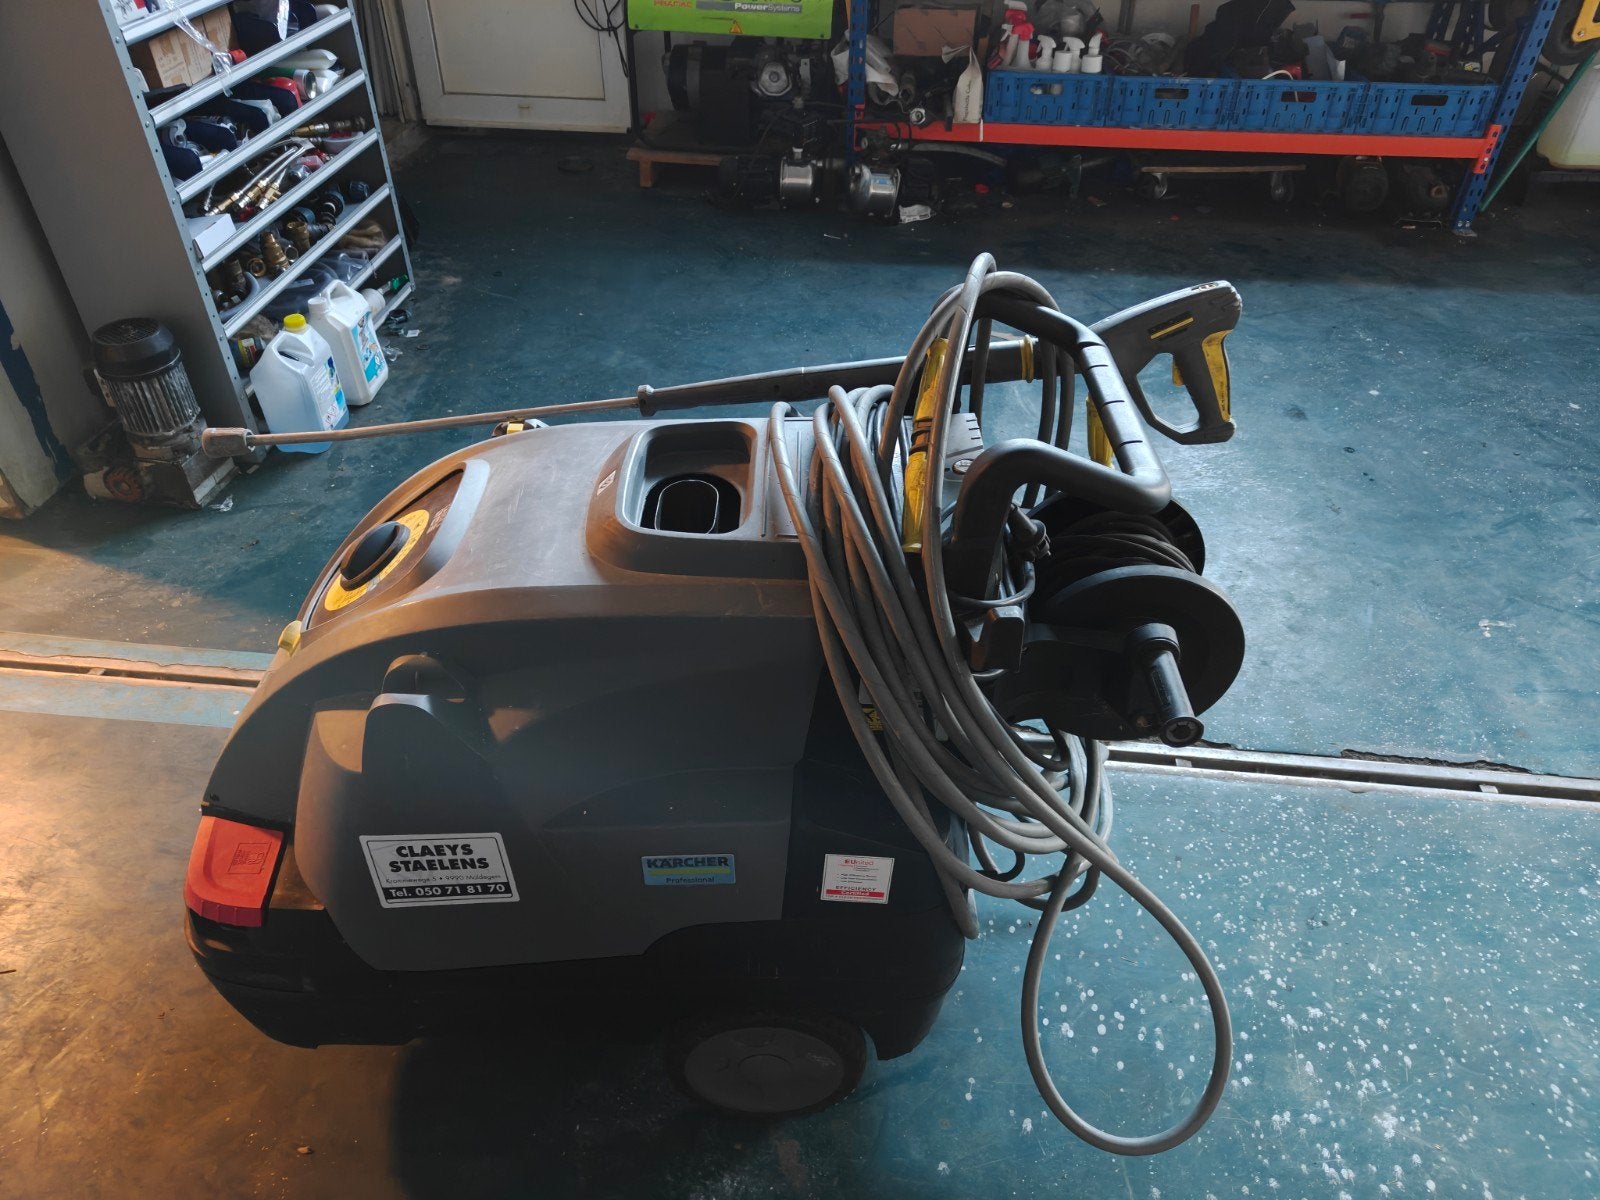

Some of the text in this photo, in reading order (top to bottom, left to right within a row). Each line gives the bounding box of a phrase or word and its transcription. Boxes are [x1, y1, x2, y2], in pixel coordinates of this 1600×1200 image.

[396, 844, 474, 858] CLAEYS
[389, 857, 490, 873] STAELENS
[646, 856, 729, 869] KÄRCHER
[665, 876, 715, 885] Professional
[389, 883, 506, 897] Tel. 050 71 81 70
